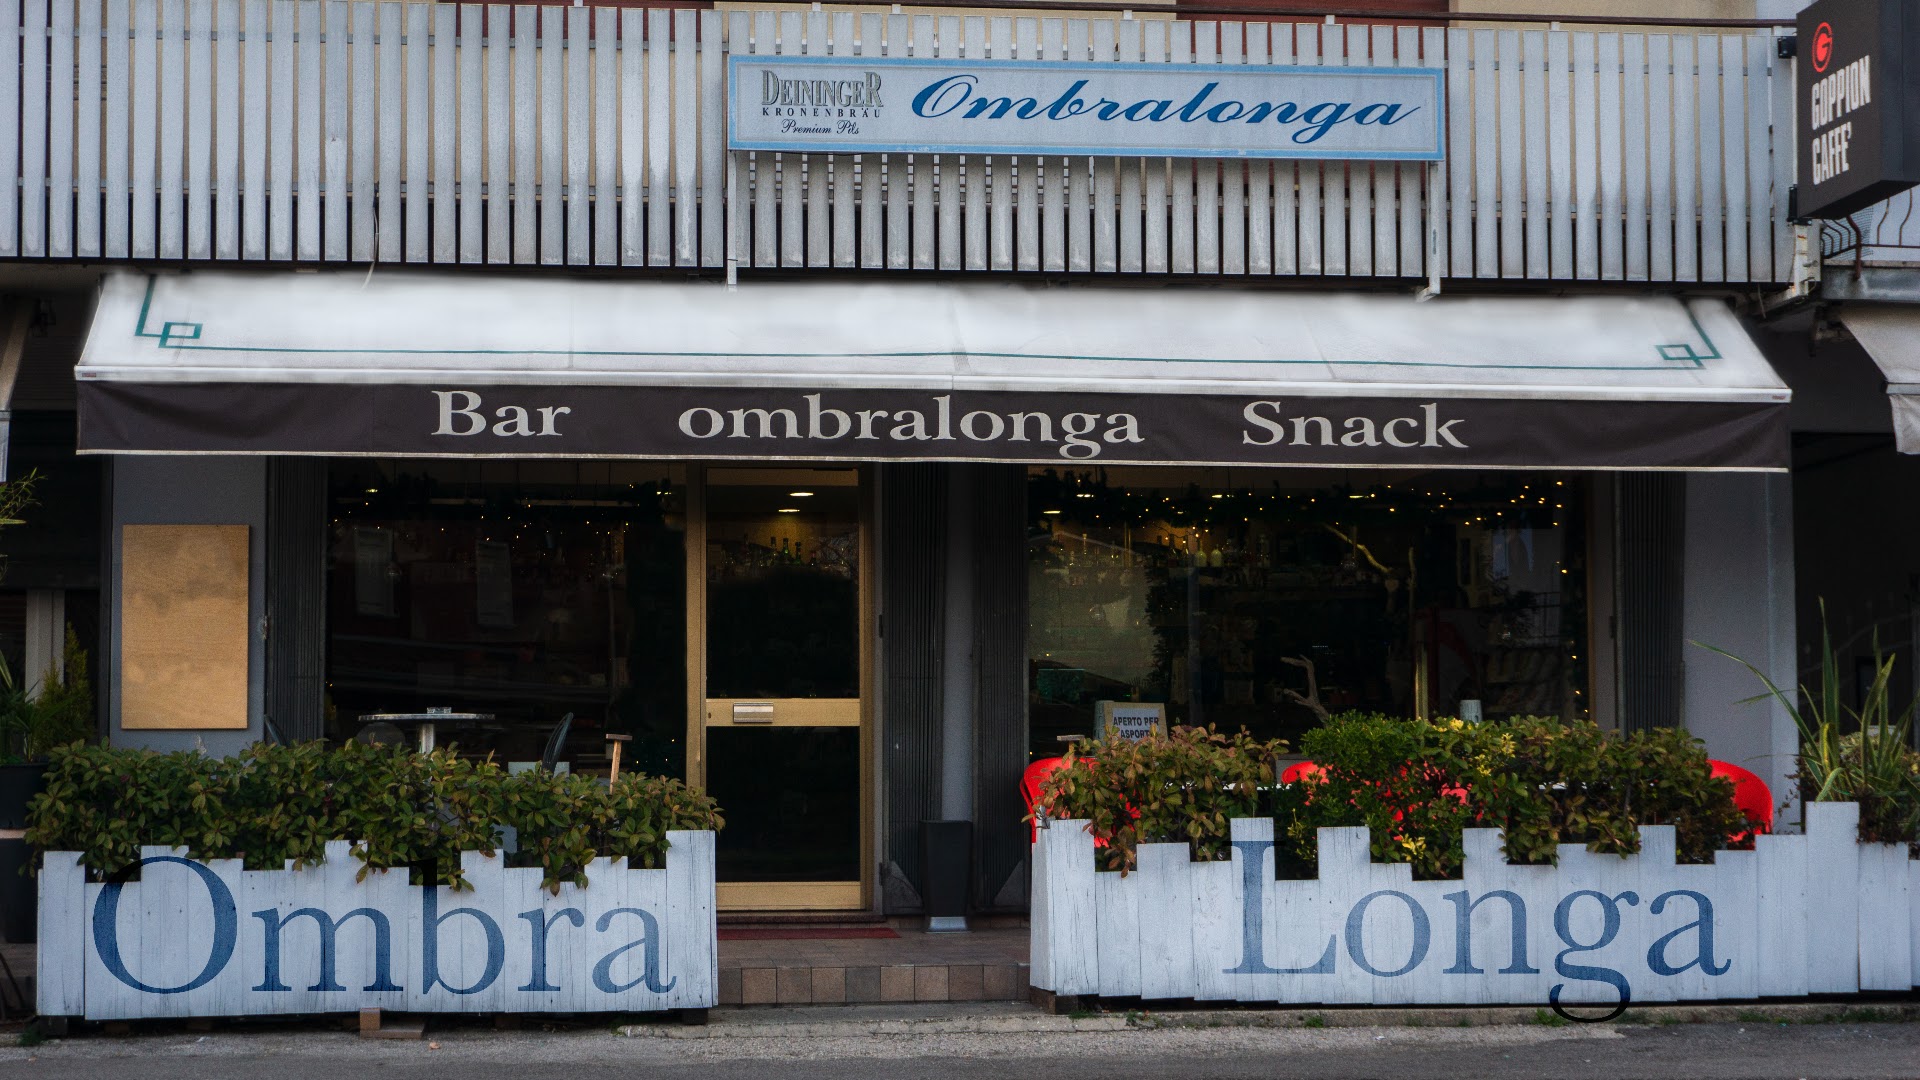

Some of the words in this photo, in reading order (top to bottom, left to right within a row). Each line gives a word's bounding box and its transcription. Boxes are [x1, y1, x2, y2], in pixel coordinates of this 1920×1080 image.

[761, 69, 884, 107] DEININGER
[1811, 55, 1871, 130] GOPPION
[762, 107, 881, 118] KRONENBRÄU
[911, 74, 1420, 144] Ombralonga
[781, 118, 832, 134] Premium
[836, 119, 860, 135] Pils
[431, 390, 571, 437] Bar
[678, 393, 1145, 459] ombralonga
[1243, 400, 1469, 448] Snack
[1113, 717, 1142, 726] APERTO
[1144, 717, 1159, 726] PER
[1120, 729, 1150, 738] ASPORT
